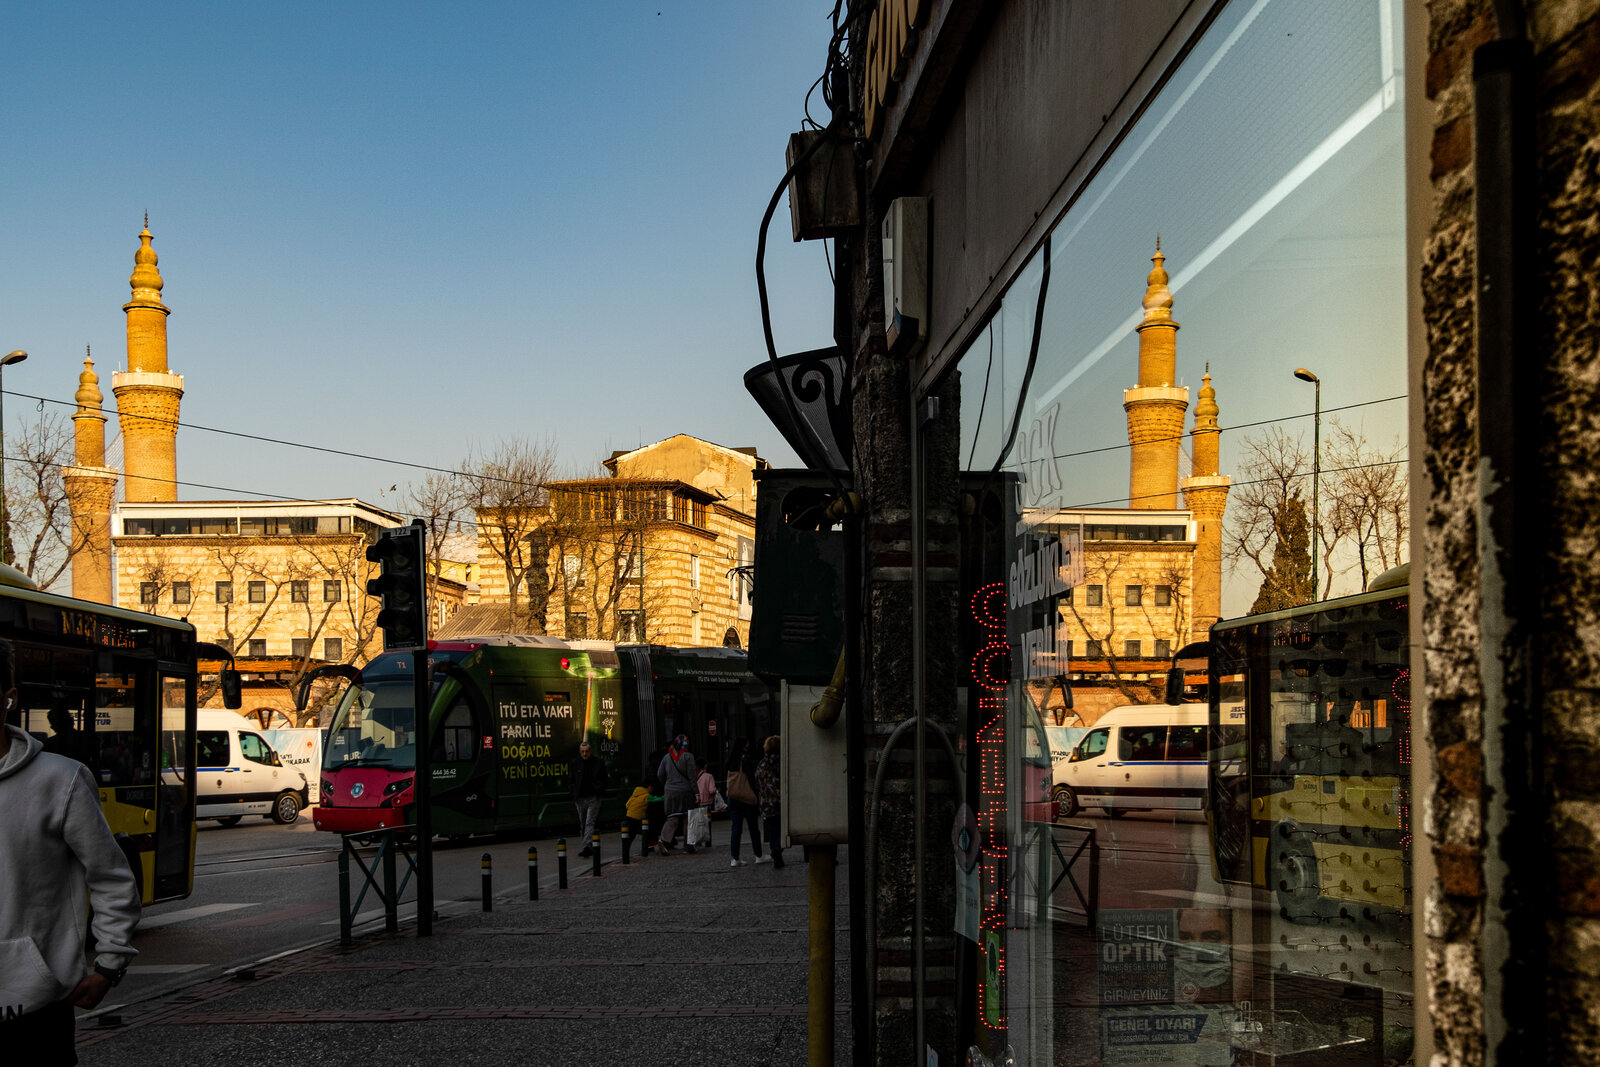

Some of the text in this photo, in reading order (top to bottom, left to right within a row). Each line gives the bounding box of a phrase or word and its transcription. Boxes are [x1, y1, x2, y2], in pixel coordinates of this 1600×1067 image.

[499, 701, 573, 718] İTÜ ETA VAKFI
[602, 697, 614, 710] İTÜ
[501, 722, 552, 738] FARKI İLE
[502, 742, 551, 759] DOĞA'DA
[502, 761, 568, 780] YENİ DÖNEM
[1102, 923, 1168, 941] LÜTFEN
[1104, 988, 1169, 1002] GİRMEYİNİZ
[1110, 1017, 1197, 1032] GENEL UYARI
